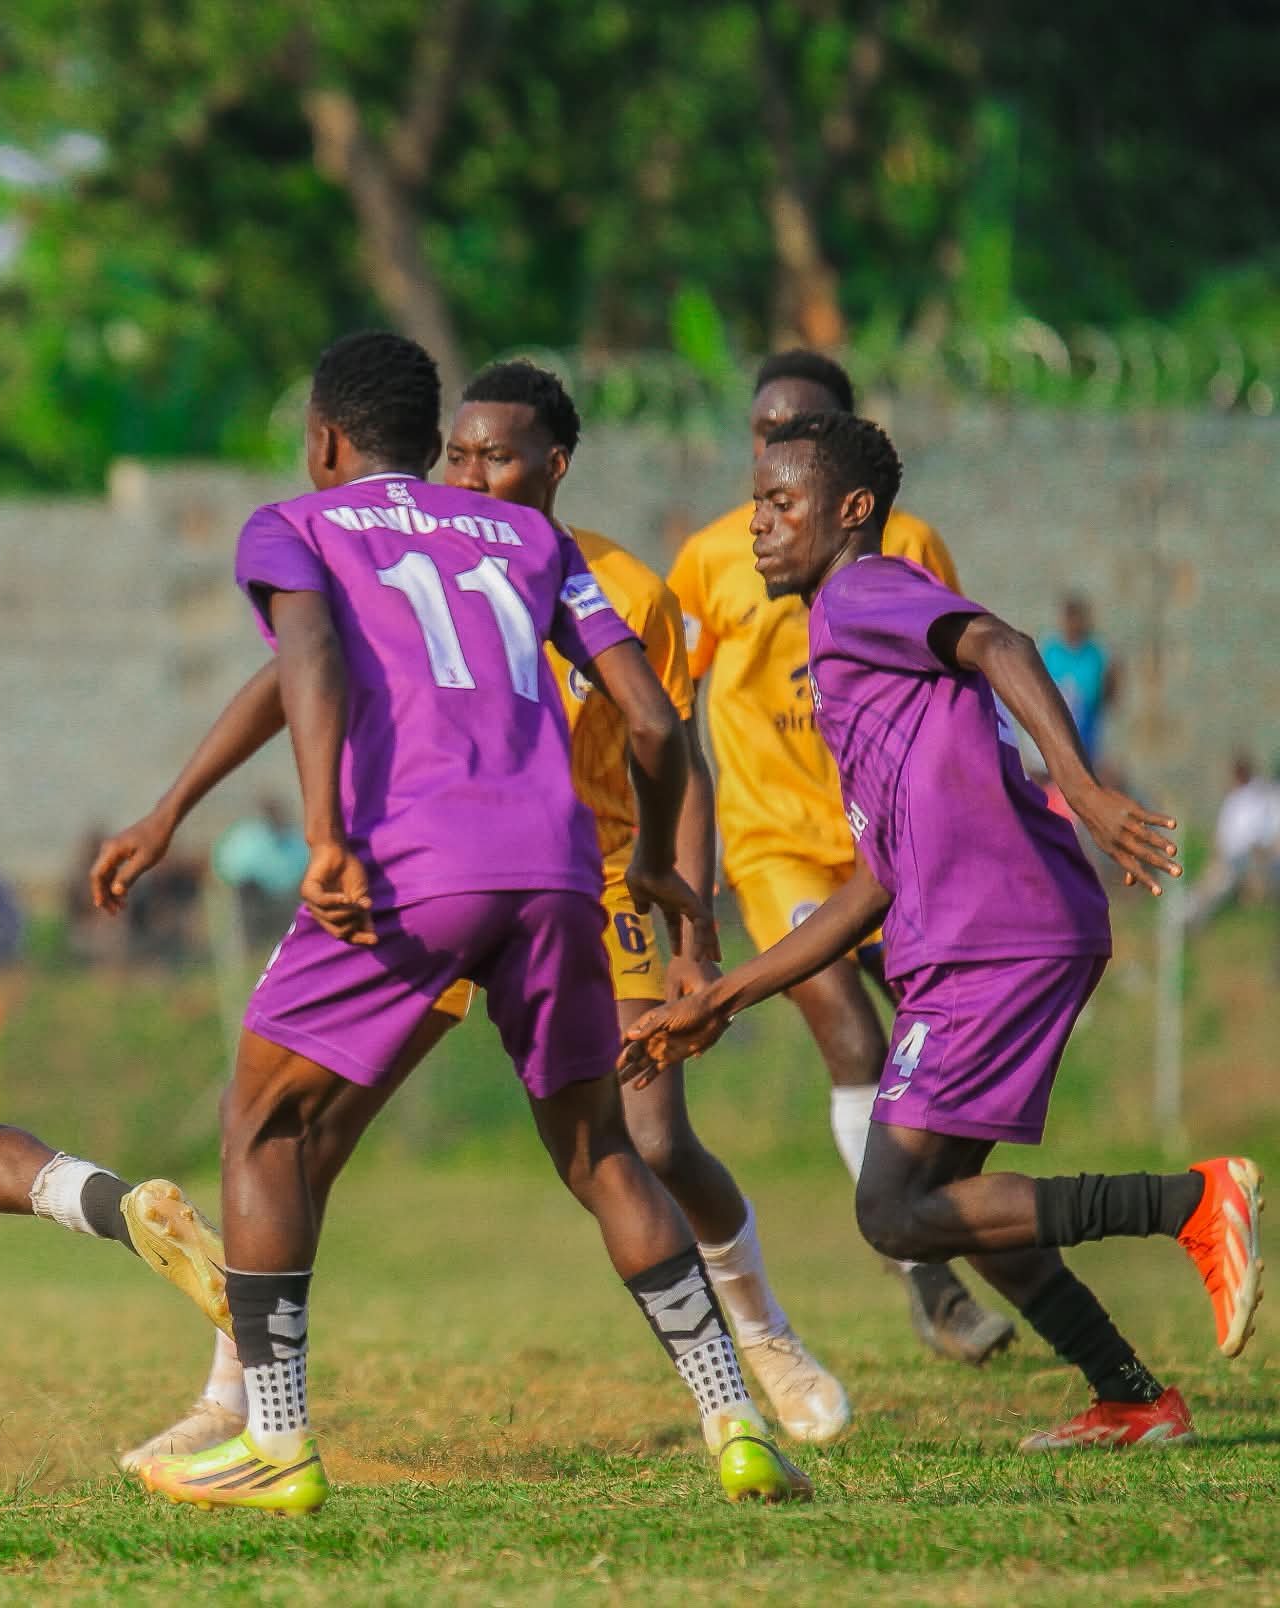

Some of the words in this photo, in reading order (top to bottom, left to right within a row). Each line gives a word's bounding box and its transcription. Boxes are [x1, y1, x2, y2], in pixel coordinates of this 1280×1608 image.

[377, 551, 538, 702] 11
[614, 912, 646, 954] 6
[892, 1022, 931, 1077] 4
